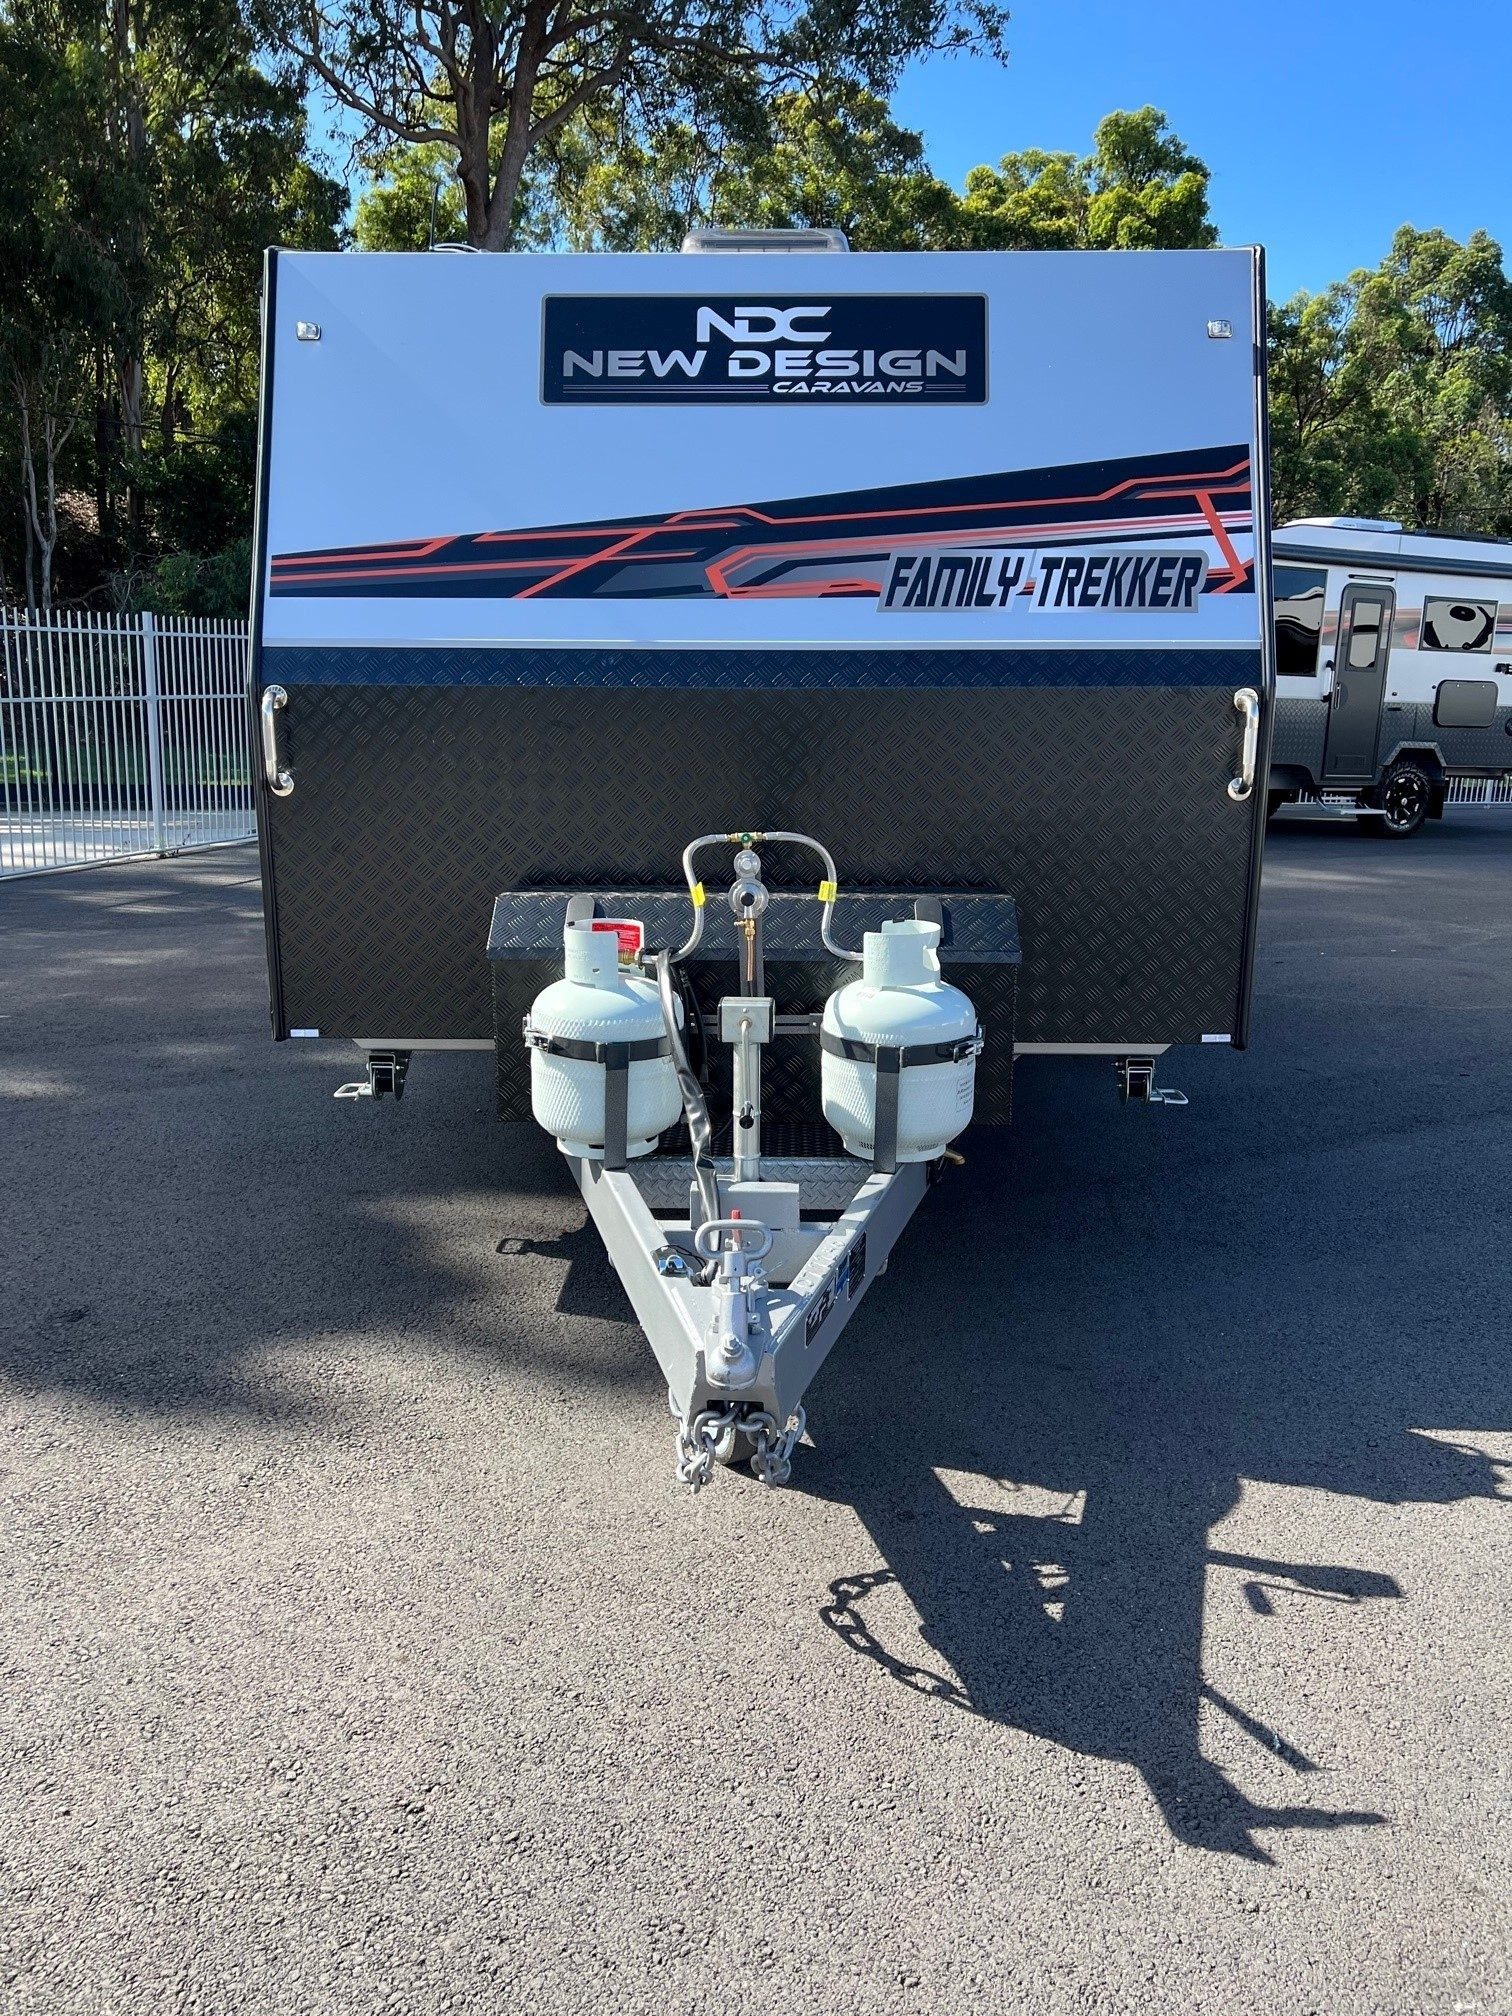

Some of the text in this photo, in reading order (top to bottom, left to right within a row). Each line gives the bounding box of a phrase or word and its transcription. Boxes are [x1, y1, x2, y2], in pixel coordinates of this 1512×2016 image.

[696, 306, 832, 342] NDC
[562, 349, 967, 377] NEW DESIGN
[772, 381, 925, 394] CARAVANS
[884, 556, 1203, 608] FAMILY TREKKER
